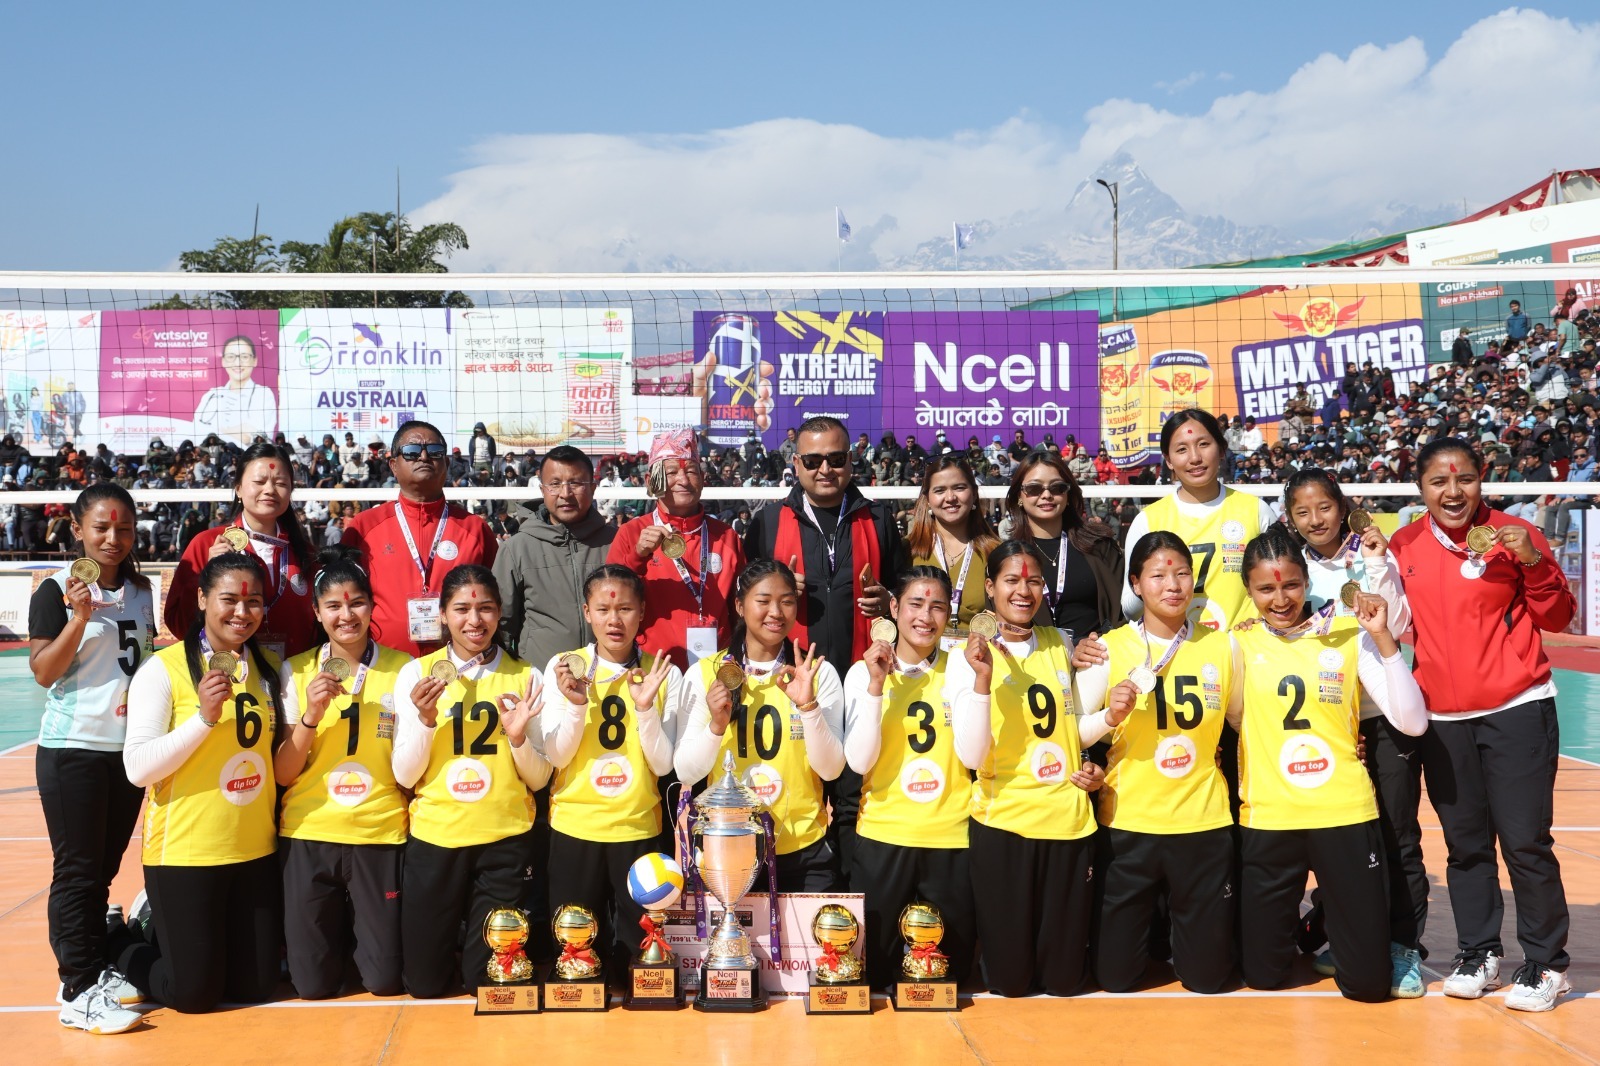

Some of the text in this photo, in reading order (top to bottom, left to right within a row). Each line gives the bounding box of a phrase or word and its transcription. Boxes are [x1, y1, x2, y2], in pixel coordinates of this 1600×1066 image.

[1574, 281, 1592, 297] AI
[1440, 297, 1458, 305] Now
[153, 329, 208, 343] vatsalya
[1108, 331, 1130, 346] CAN
[338, 341, 442, 365] Franklin
[1238, 325, 1425, 391] MAX TIGER
[464, 360, 553, 374] ज्ञान चक्की आटा
[779, 353, 877, 379] XTREME
[914, 341, 1070, 392] Ncell
[779, 380, 876, 395] ENERGY DRINK
[317, 391, 427, 408] AUSTRALIA
[1243, 380, 1339, 419] ENEGY
[915, 398, 1070, 427] नेपालकै लागि
[117, 620, 141, 676] 5
[1027, 683, 1057, 738] 9
[1150, 675, 1204, 730] 15
[1277, 674, 1311, 730] 2
[235, 692, 263, 748] 6
[447, 701, 498, 755] 12
[598, 694, 627, 750] 8
[907, 700, 936, 753] 3
[340, 702, 360, 756] 1
[737, 704, 782, 760] 10
[1041, 764, 1061, 776] tip top
[1166, 756, 1190, 767] tip top
[1293, 760, 1324, 773] tip top
[233, 776, 258, 790] tip top
[457, 782, 482, 791] tip top
[600, 775, 624, 785] tip top
[911, 780, 936, 790] tip top
[339, 784, 364, 795] tip top
[643, 969, 665, 977] Ncell
[768, 959, 811, 971] WOMEN
